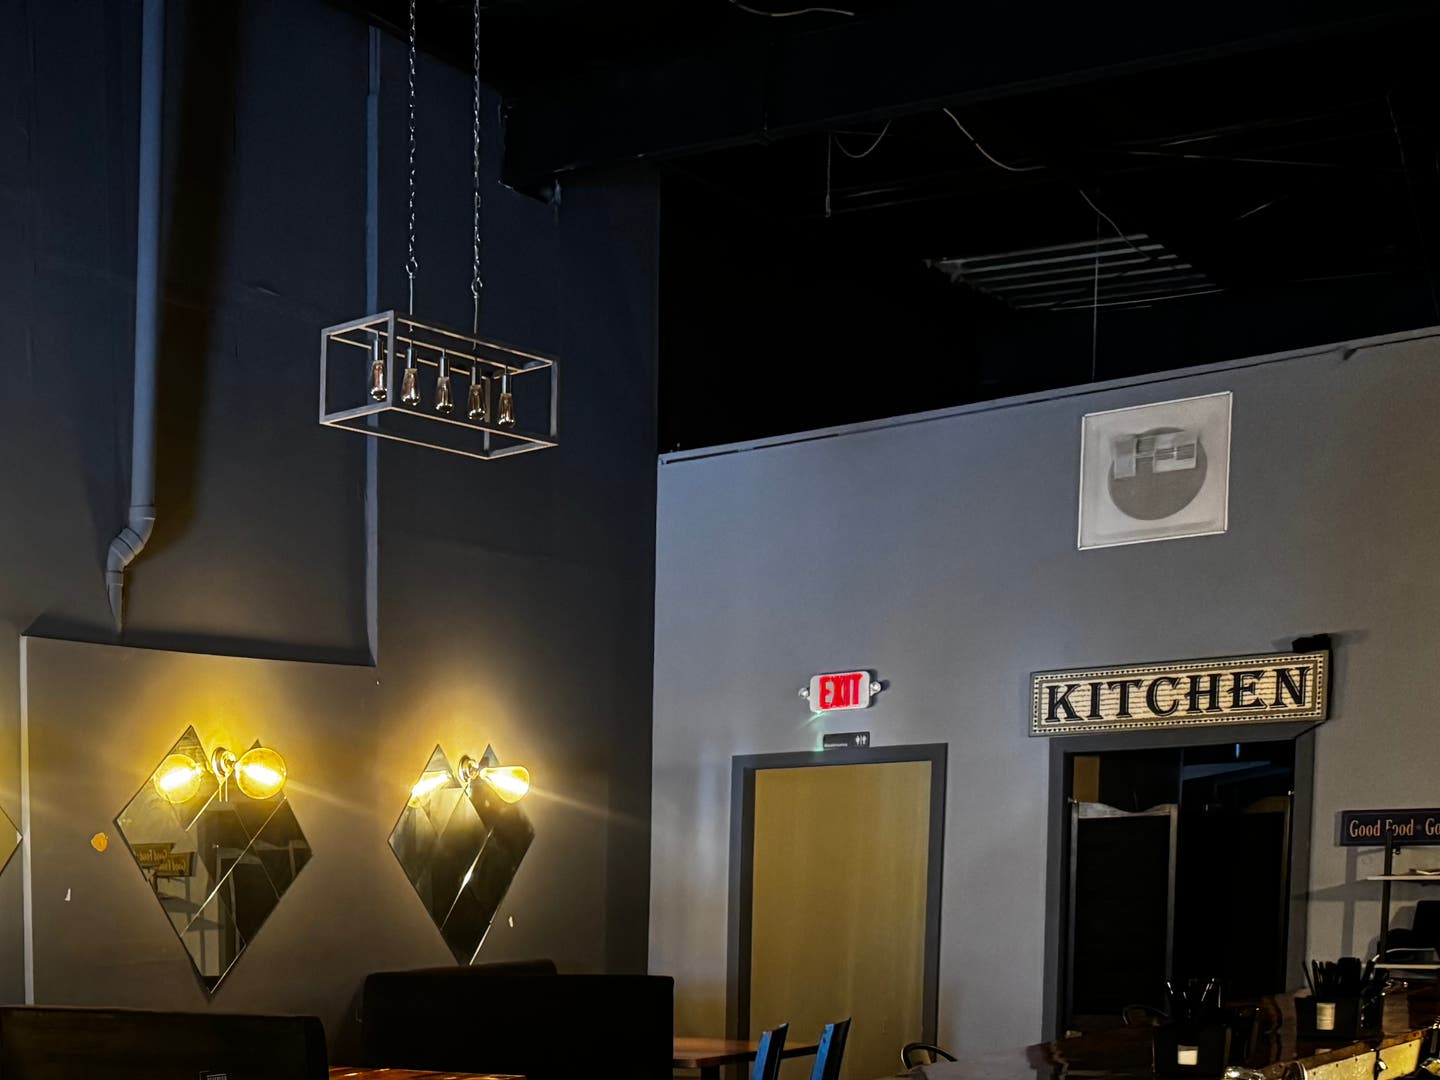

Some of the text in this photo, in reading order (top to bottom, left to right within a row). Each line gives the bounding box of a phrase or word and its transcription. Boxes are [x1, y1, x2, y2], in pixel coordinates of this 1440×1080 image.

[819, 673, 864, 710] EXIT
[1044, 665, 1313, 723] KITCHEN
[1349, 819, 1381, 838] Good
[1385, 818, 1414, 836] Food
